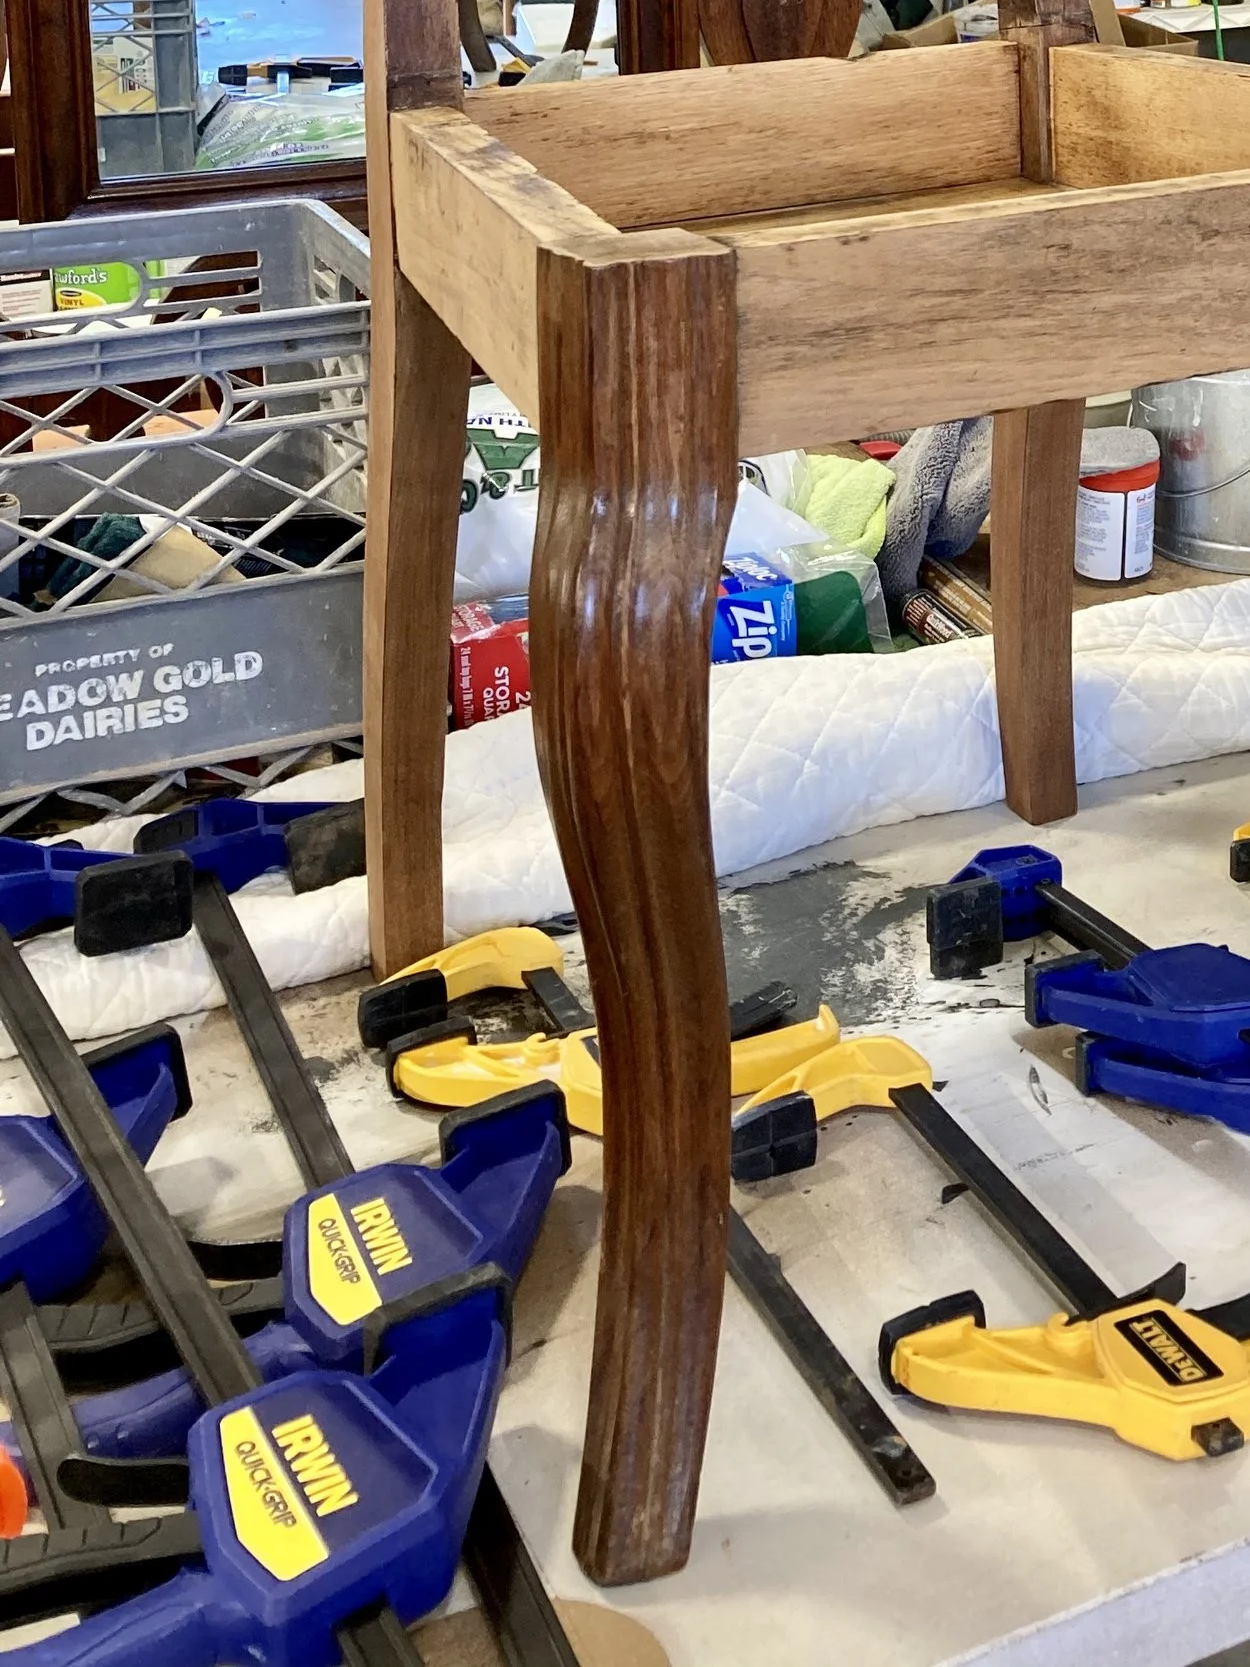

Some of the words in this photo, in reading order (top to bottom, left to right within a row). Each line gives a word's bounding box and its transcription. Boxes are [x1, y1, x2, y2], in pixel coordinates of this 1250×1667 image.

[728, 600, 778, 658] Zip
[0, 669, 145, 722] EADOW
[152, 650, 264, 694] GOLD
[35, 648, 141, 677] PROPERTY
[148, 642, 175, 659] OF
[494, 665, 511, 717] STOR
[26, 694, 190, 751] DAIRIES
[351, 1197, 413, 1276] IRWIN
[271, 1413, 360, 1518] IRWIN
